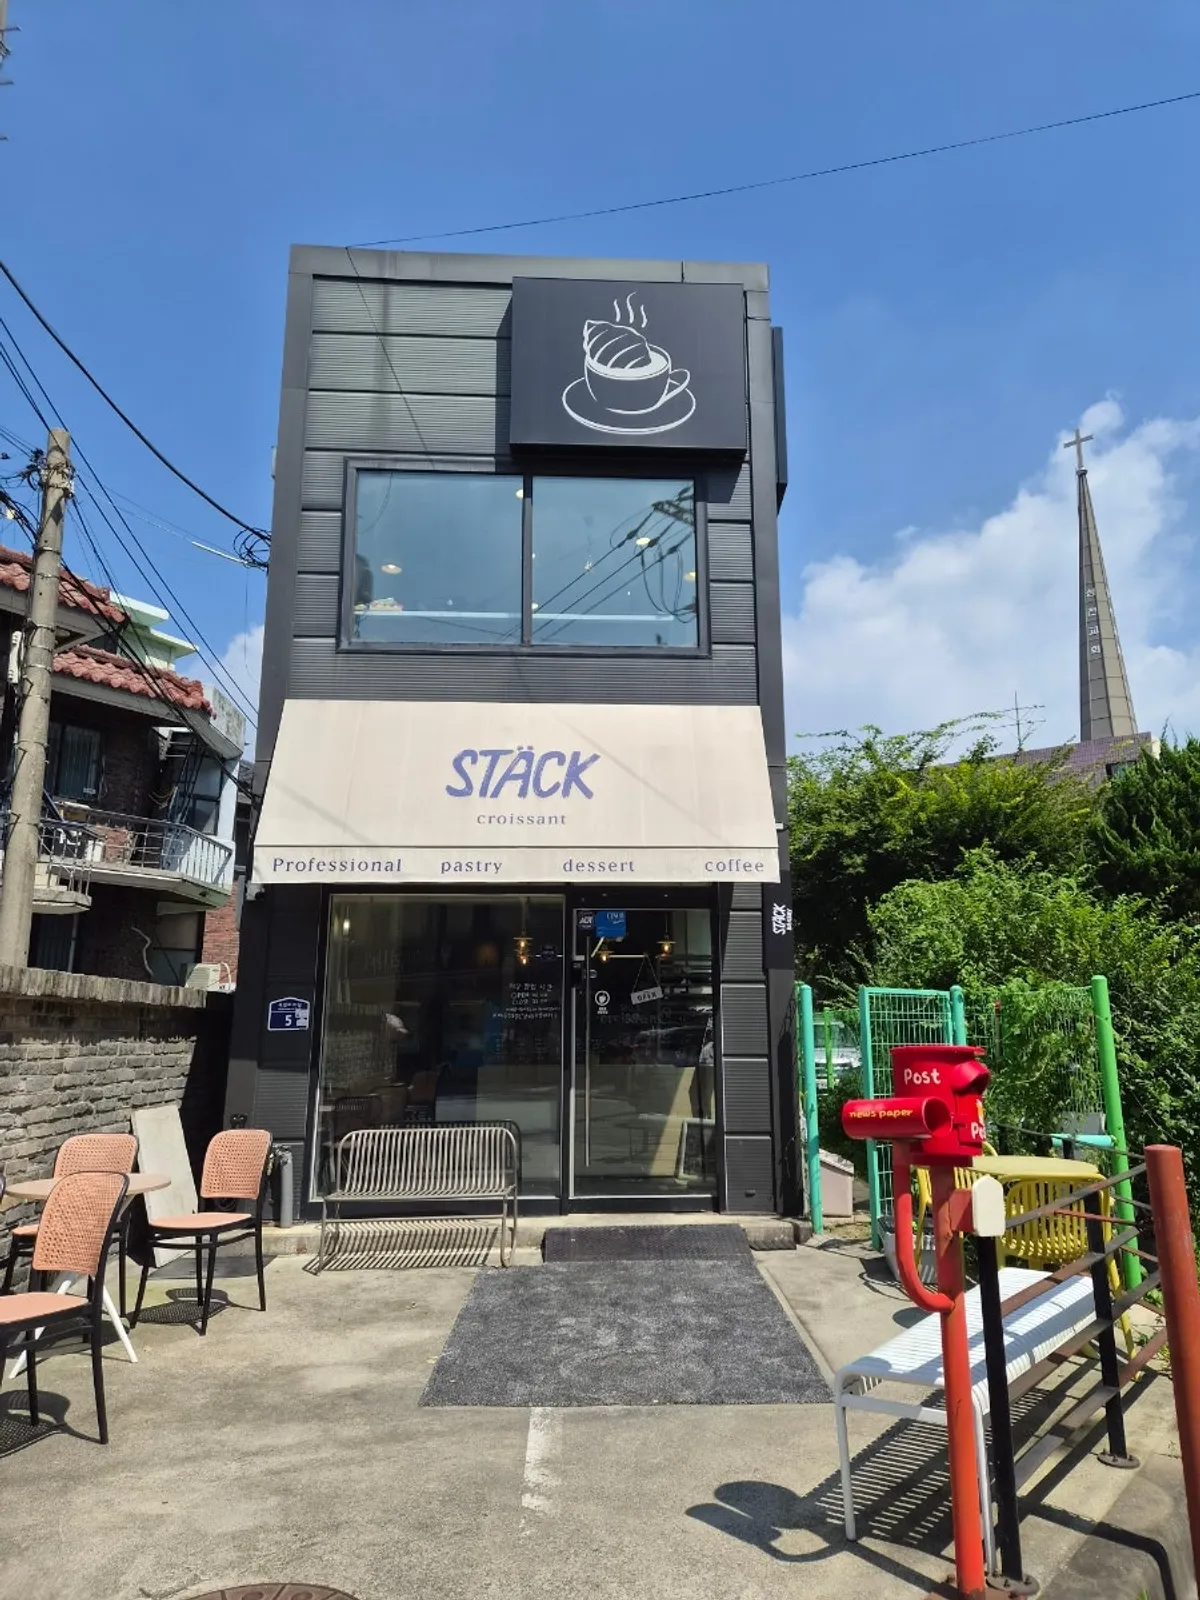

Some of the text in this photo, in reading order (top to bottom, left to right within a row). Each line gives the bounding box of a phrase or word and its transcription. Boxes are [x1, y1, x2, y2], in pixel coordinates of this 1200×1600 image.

[446, 746, 601, 799] STÄCK
[477, 813, 567, 825] croissant
[272, 857, 765, 875] Professional pastry dessert coffee
[285, 1014, 292, 1026] 5
[904, 1068, 941, 1085] Post
